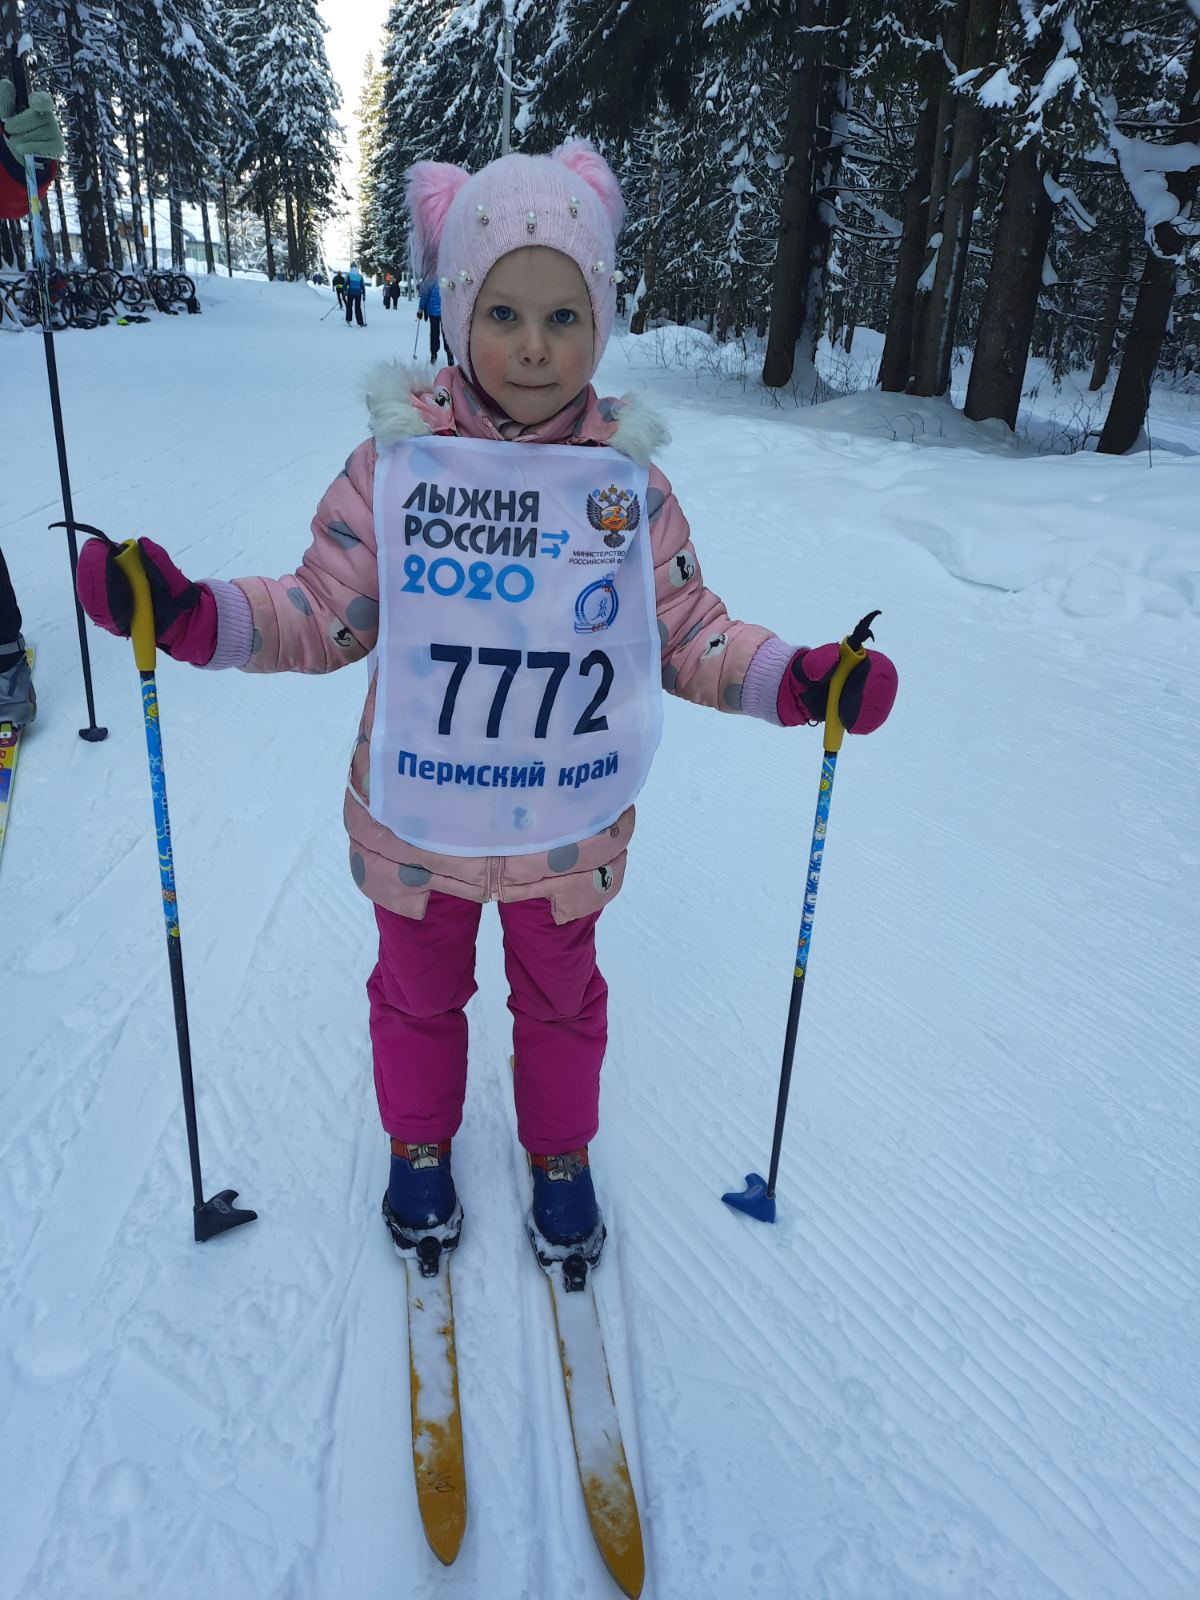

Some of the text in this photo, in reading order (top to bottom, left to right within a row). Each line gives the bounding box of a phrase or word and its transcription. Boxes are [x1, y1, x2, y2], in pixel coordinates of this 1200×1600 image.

[402, 482, 540, 522] ЛЫЖНЯ
[404, 515, 538, 558] РОССИИ
[401, 554, 534, 602] 2020
[568, 557, 615, 565] РОССИЙСКОЙ
[430, 643, 614, 738] 7772
[398, 750, 618, 788] Пермский край
